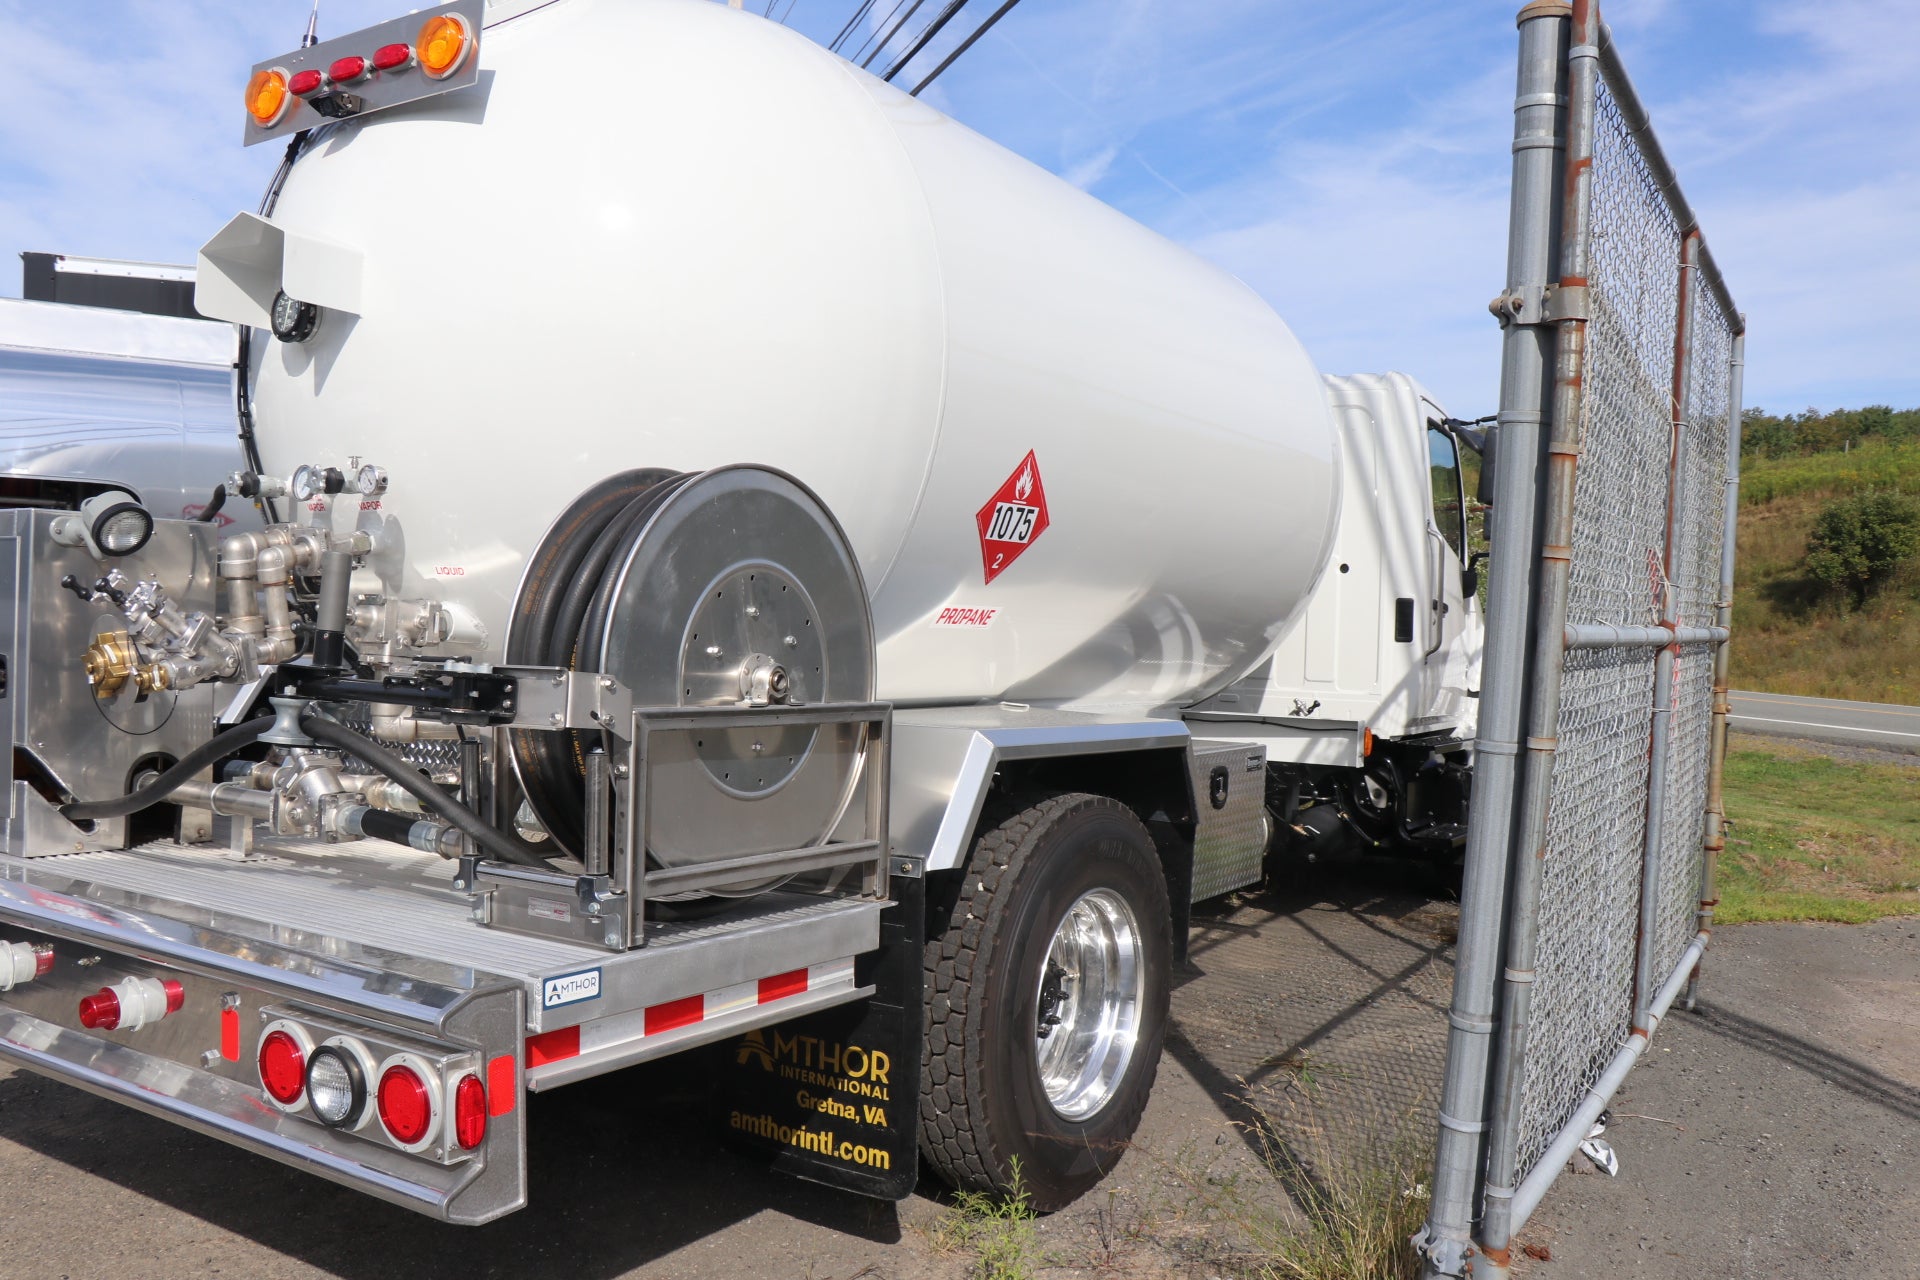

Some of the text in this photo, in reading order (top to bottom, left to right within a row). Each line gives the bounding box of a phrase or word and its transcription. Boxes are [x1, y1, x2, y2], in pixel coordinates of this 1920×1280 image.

[307, 503, 326, 512] VAPOR
[358, 500, 383, 511] VAPOR
[988, 505, 1036, 541] 1075
[435, 566, 465, 576] LIQUID
[991, 553, 1004, 569] 2
[935, 607, 997, 626] PROPANE
[548, 976, 598, 1002] AMTHOR
[736, 1028, 891, 1085] AMTHOR
[780, 1063, 890, 1101] INTERNATIONAL
[796, 1089, 888, 1128] Gretna, VA
[730, 1110, 890, 1170] amthorintl.com
